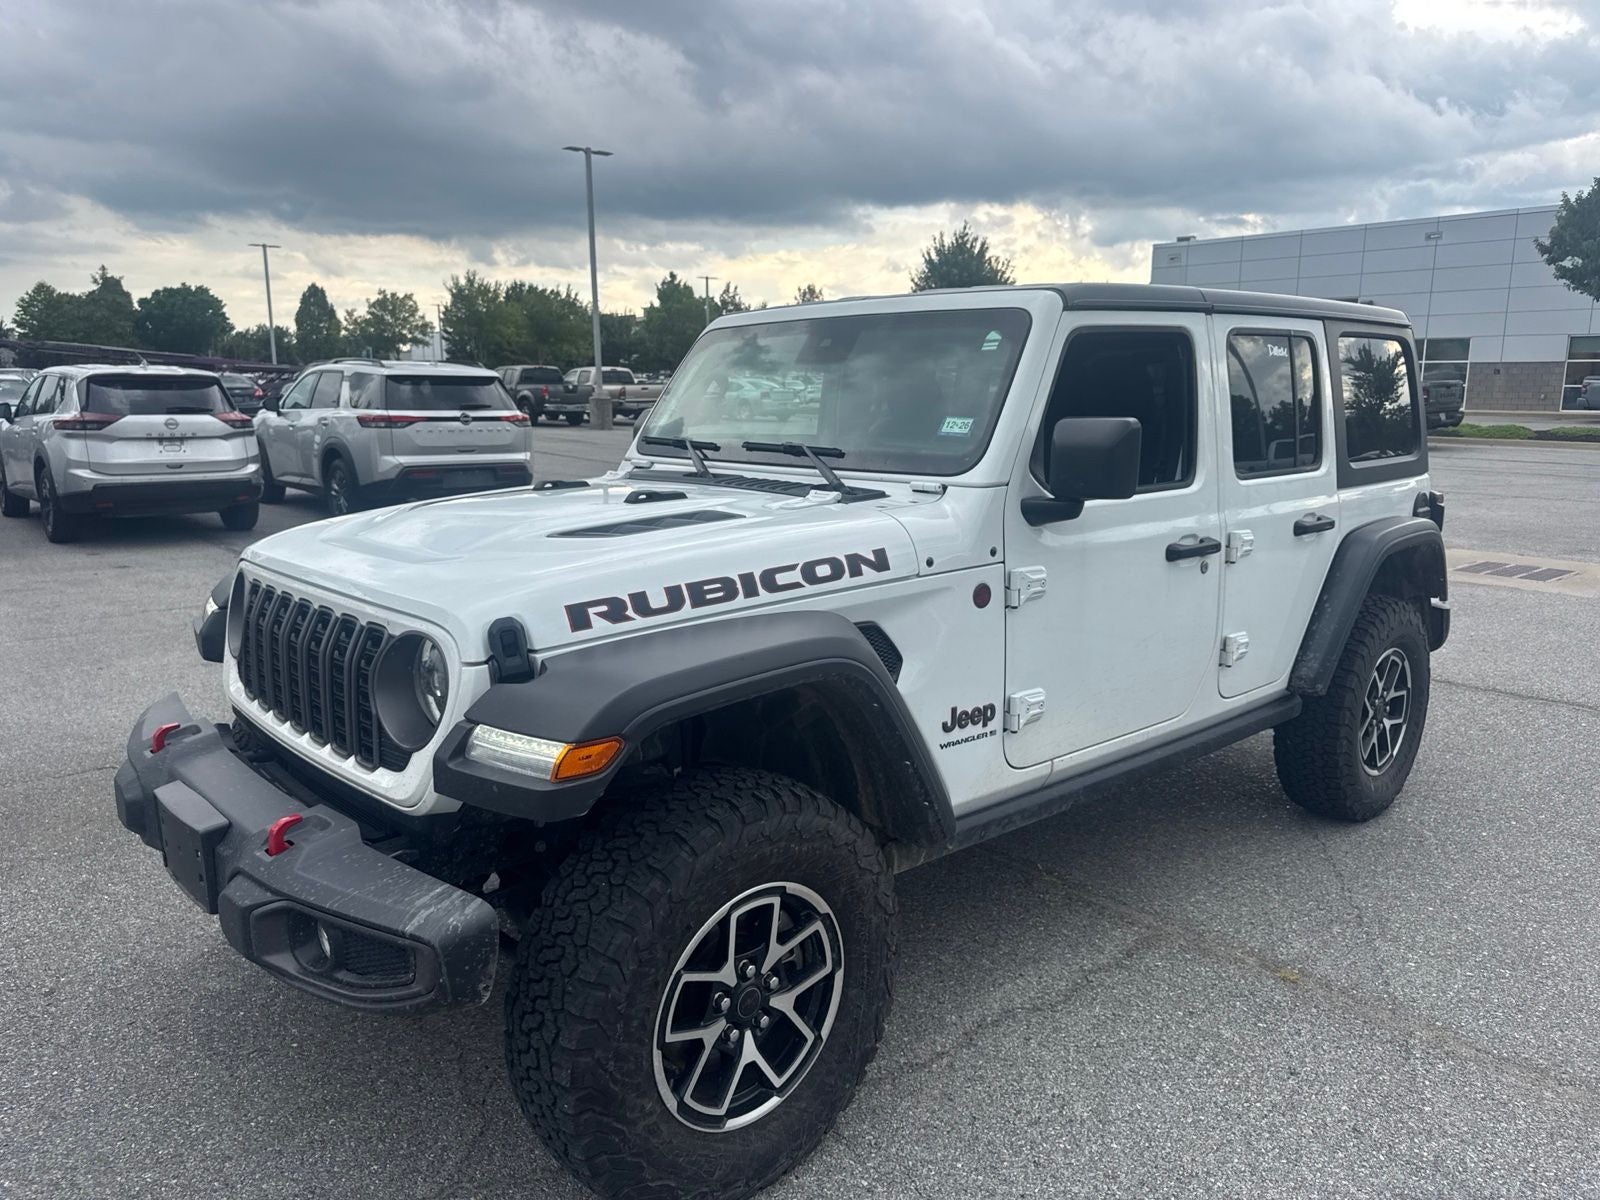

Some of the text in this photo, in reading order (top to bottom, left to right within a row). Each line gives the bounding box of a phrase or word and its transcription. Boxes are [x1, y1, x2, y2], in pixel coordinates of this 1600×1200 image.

[564, 547, 891, 633] RUBICON
[942, 703, 996, 734] Jeep
[939, 731, 988, 750] WRANGLER
